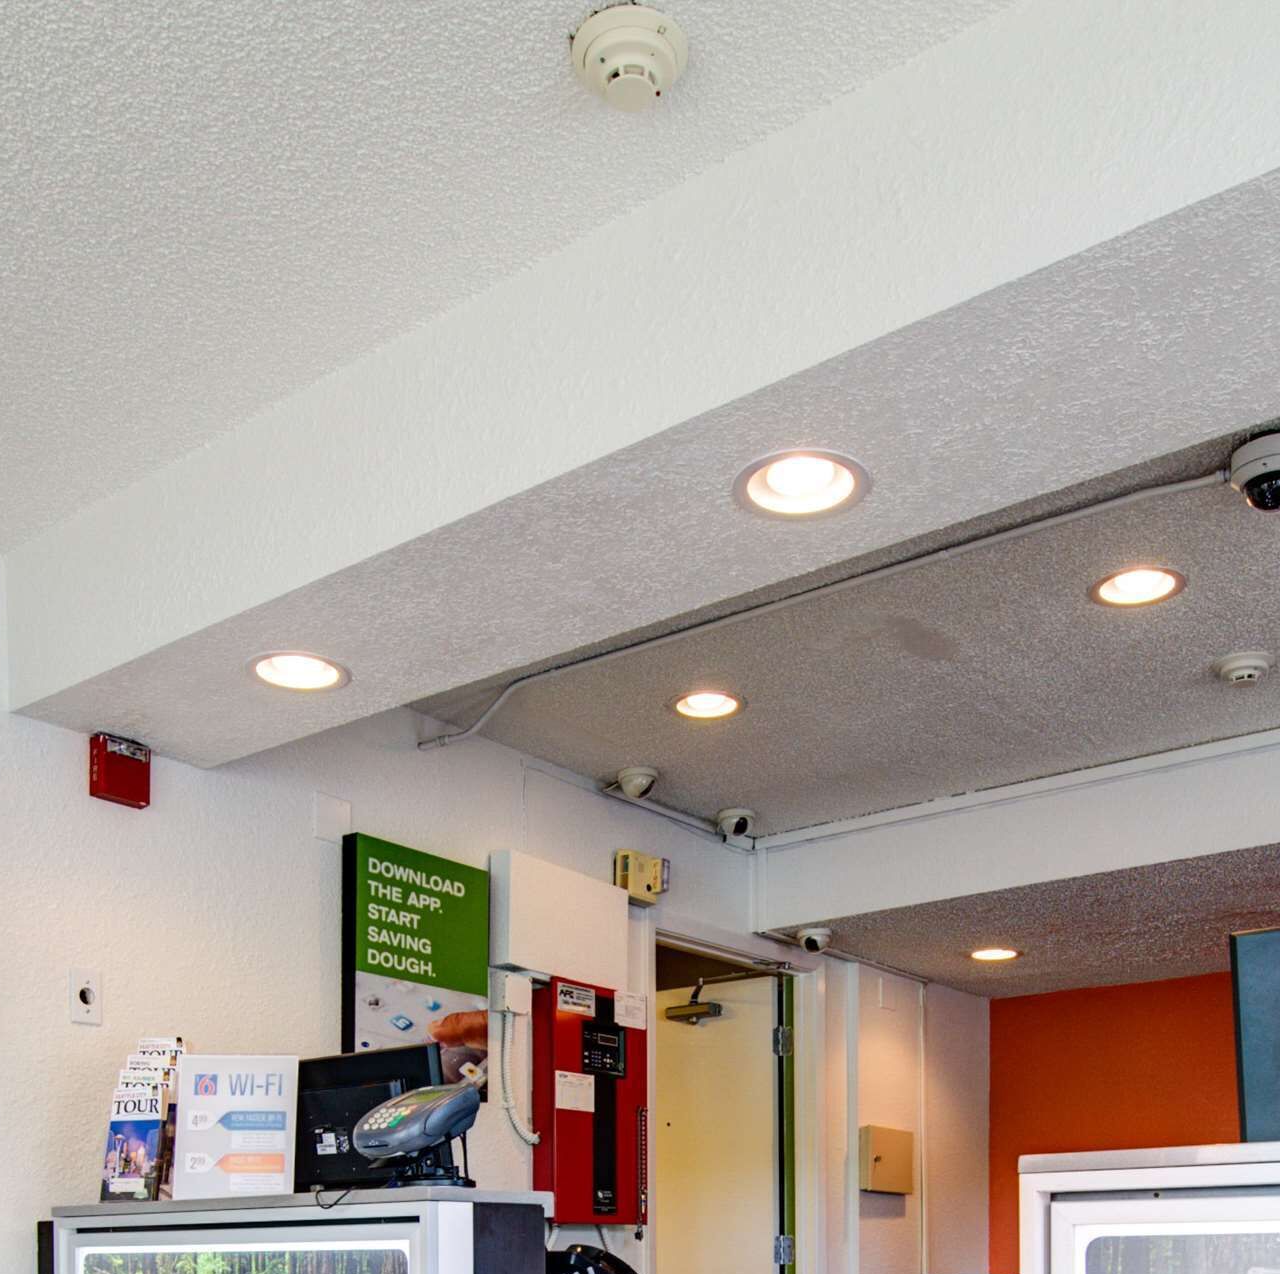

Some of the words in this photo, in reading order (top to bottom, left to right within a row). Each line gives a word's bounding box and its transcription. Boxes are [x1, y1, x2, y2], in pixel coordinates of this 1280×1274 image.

[368, 857, 466, 897] DOWNLOAD
[367, 880, 403, 904] THE
[407, 891, 444, 915] APP.
[367, 903, 421, 930] START
[367, 926, 432, 955] SAVING
[367, 948, 437, 978] DOUGH.
[228, 1073, 284, 1097] WI-FI
[114, 1097, 160, 1116] TOUR
